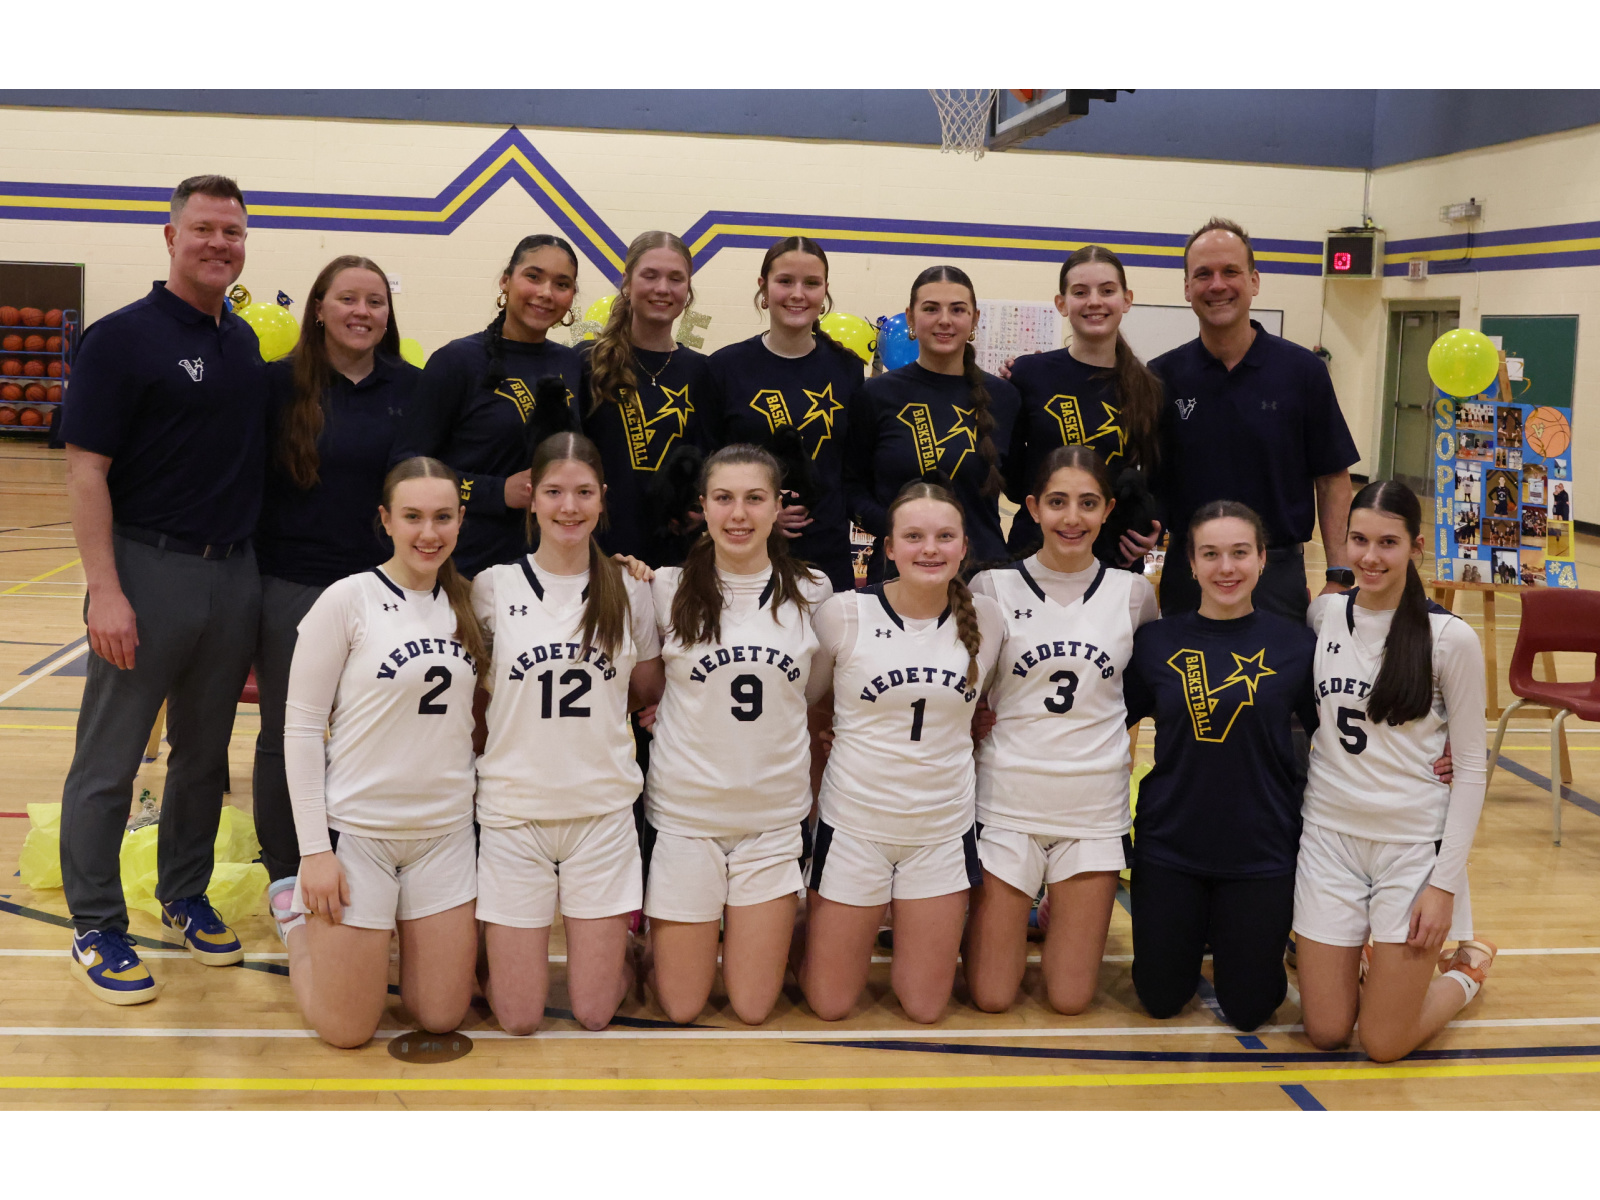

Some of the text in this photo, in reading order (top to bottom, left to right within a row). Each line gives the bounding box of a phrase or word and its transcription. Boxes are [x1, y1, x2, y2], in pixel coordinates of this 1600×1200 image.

[1435, 398, 1456, 582] SOPHIE
[1548, 561, 1578, 589] #4
[508, 642, 617, 682] VEDETTES
[689, 645, 801, 683] VEDETTES
[1012, 640, 1115, 680] VEDETTES
[418, 665, 452, 714] 2
[537, 668, 592, 719] 12
[730, 673, 763, 722] 9
[860, 667, 977, 703] VEDETTES
[1043, 670, 1080, 714] 3
[1185, 655, 1212, 736] BASKETBALL
[910, 698, 926, 742] 1
[1337, 706, 1368, 756] 5
